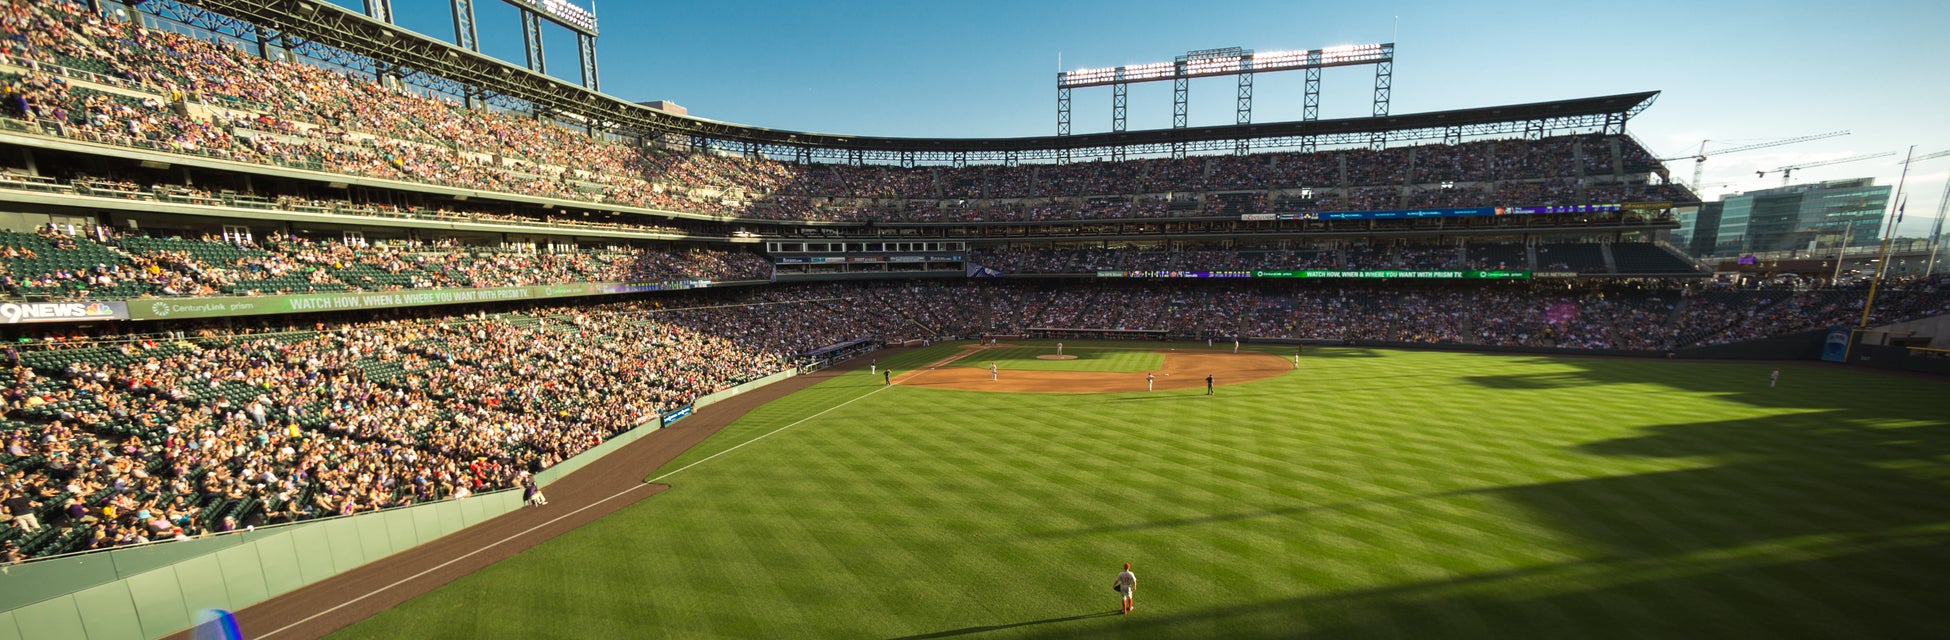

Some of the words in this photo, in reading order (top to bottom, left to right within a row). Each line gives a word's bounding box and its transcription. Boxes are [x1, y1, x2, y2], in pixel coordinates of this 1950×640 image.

[172, 303, 226, 313] CenturyLink
[230, 302, 254, 311] prism
[289, 297, 331, 310] WATCH
[334, 296, 362, 309] HOW,
[362, 294, 393, 306] WHEN
[394, 294, 402, 304] &
[403, 292, 434, 304] WHERE
[435, 292, 452, 302] YOU
[454, 290, 477, 301] WANT
[477, 289, 497, 300] WITH
[497, 289, 519, 299] PRISM
